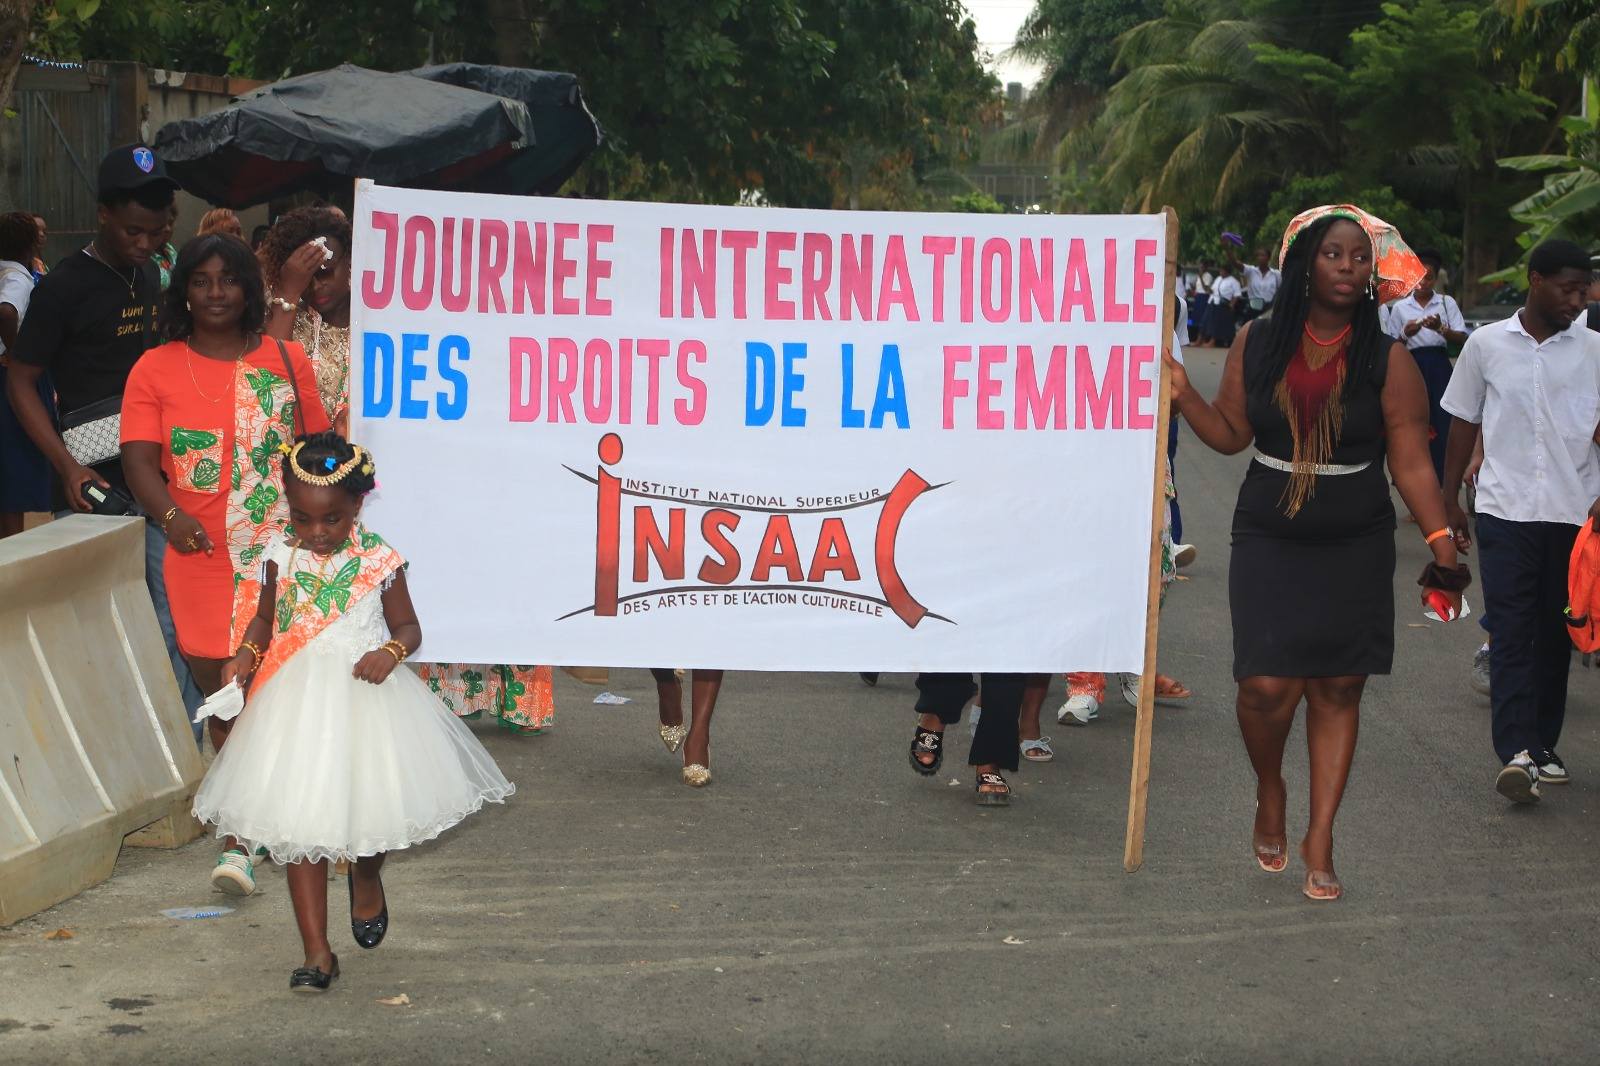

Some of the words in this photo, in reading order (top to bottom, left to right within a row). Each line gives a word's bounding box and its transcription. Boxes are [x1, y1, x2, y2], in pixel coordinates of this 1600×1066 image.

[361, 210, 615, 316] JOURNEE
[659, 227, 1158, 324] INTERNATIONALE
[362, 331, 471, 421] DES
[508, 336, 708, 426] DROITS
[744, 341, 808, 428] DE
[840, 343, 911, 429] LA
[942, 345, 1155, 430] FEMME
[625, 478, 700, 500] INSTITUT
[707, 489, 787, 508] NATIONAL
[795, 488, 882, 508] SUPERIEUR
[623, 601, 651, 616] DES
[657, 595, 698, 609] ARTS
[702, 593, 719, 606] ET
[722, 592, 739, 606] DE
[743, 591, 798, 606] L'ACTION
[801, 593, 884, 618] CULTURELLE
